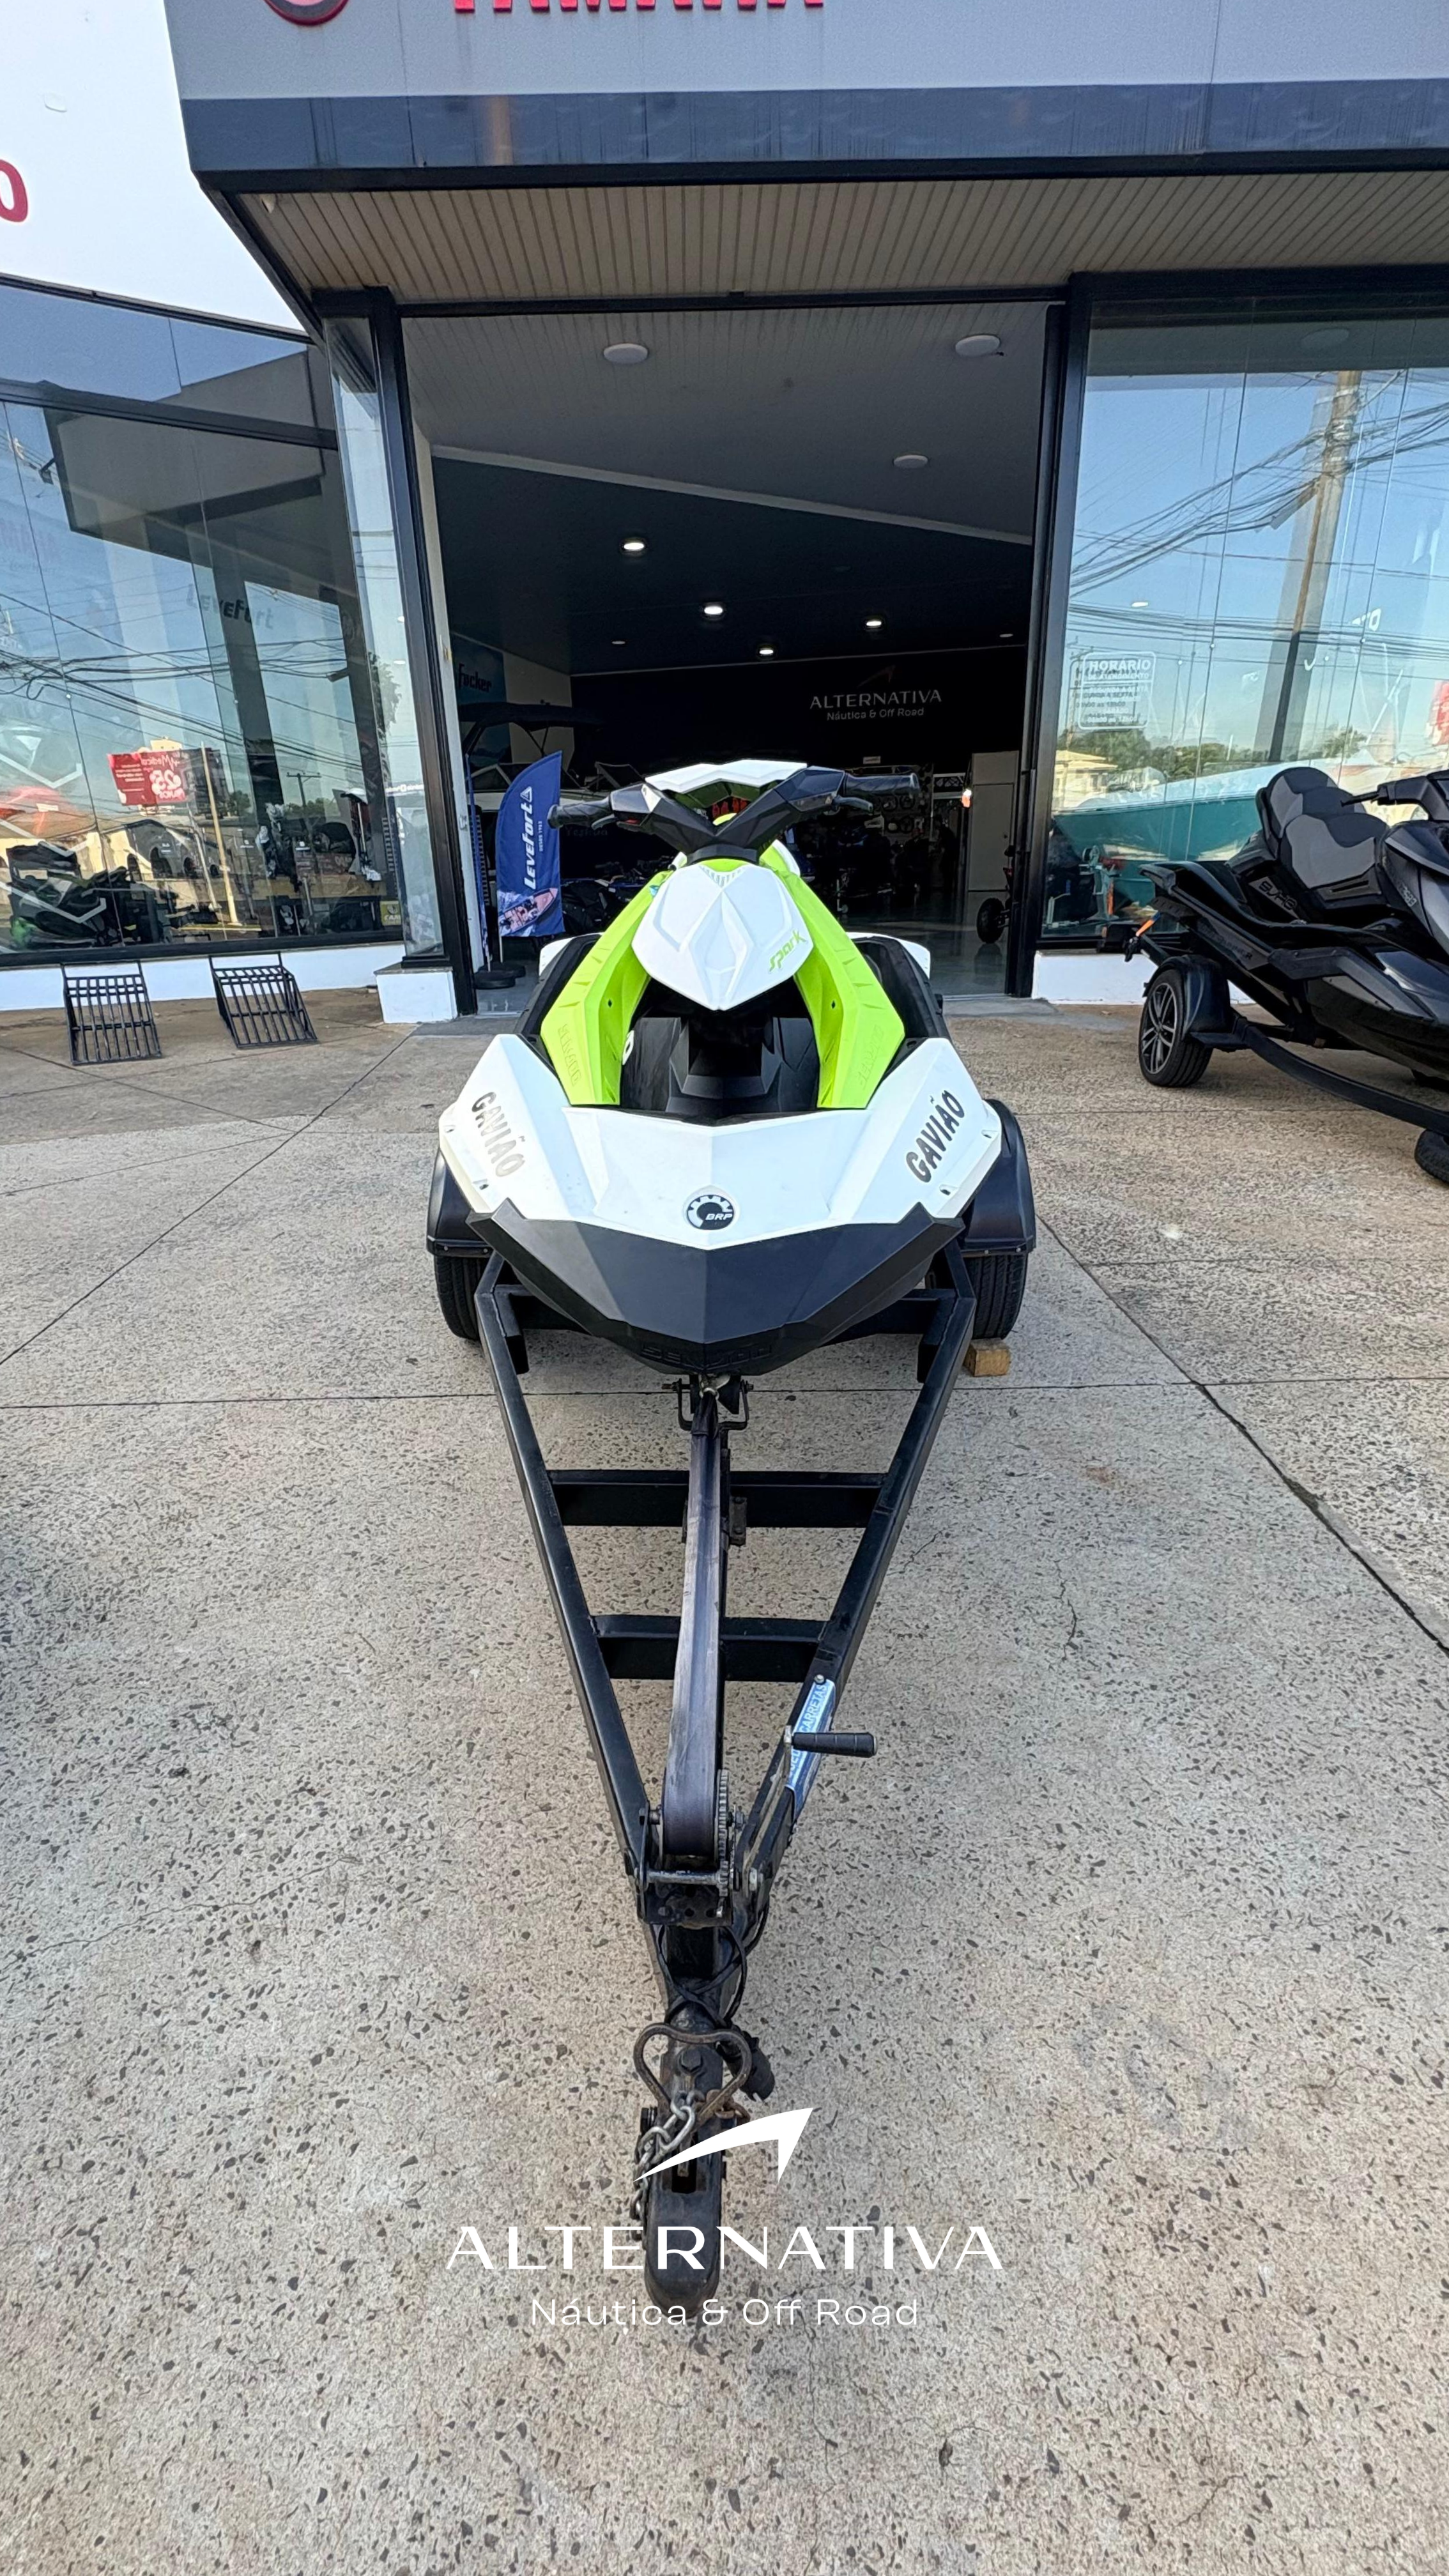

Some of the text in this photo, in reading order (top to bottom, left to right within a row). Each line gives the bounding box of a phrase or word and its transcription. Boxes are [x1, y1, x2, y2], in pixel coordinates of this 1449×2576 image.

[810, 689, 942, 709] ALTERNATIVA
[827, 707, 924, 721] Náutica & Off Road
[471, 1091, 525, 1177] GAVIÃO
[906, 1090, 965, 1183] GAVIÃO
[798, 1684, 827, 1733] CARRETAS
